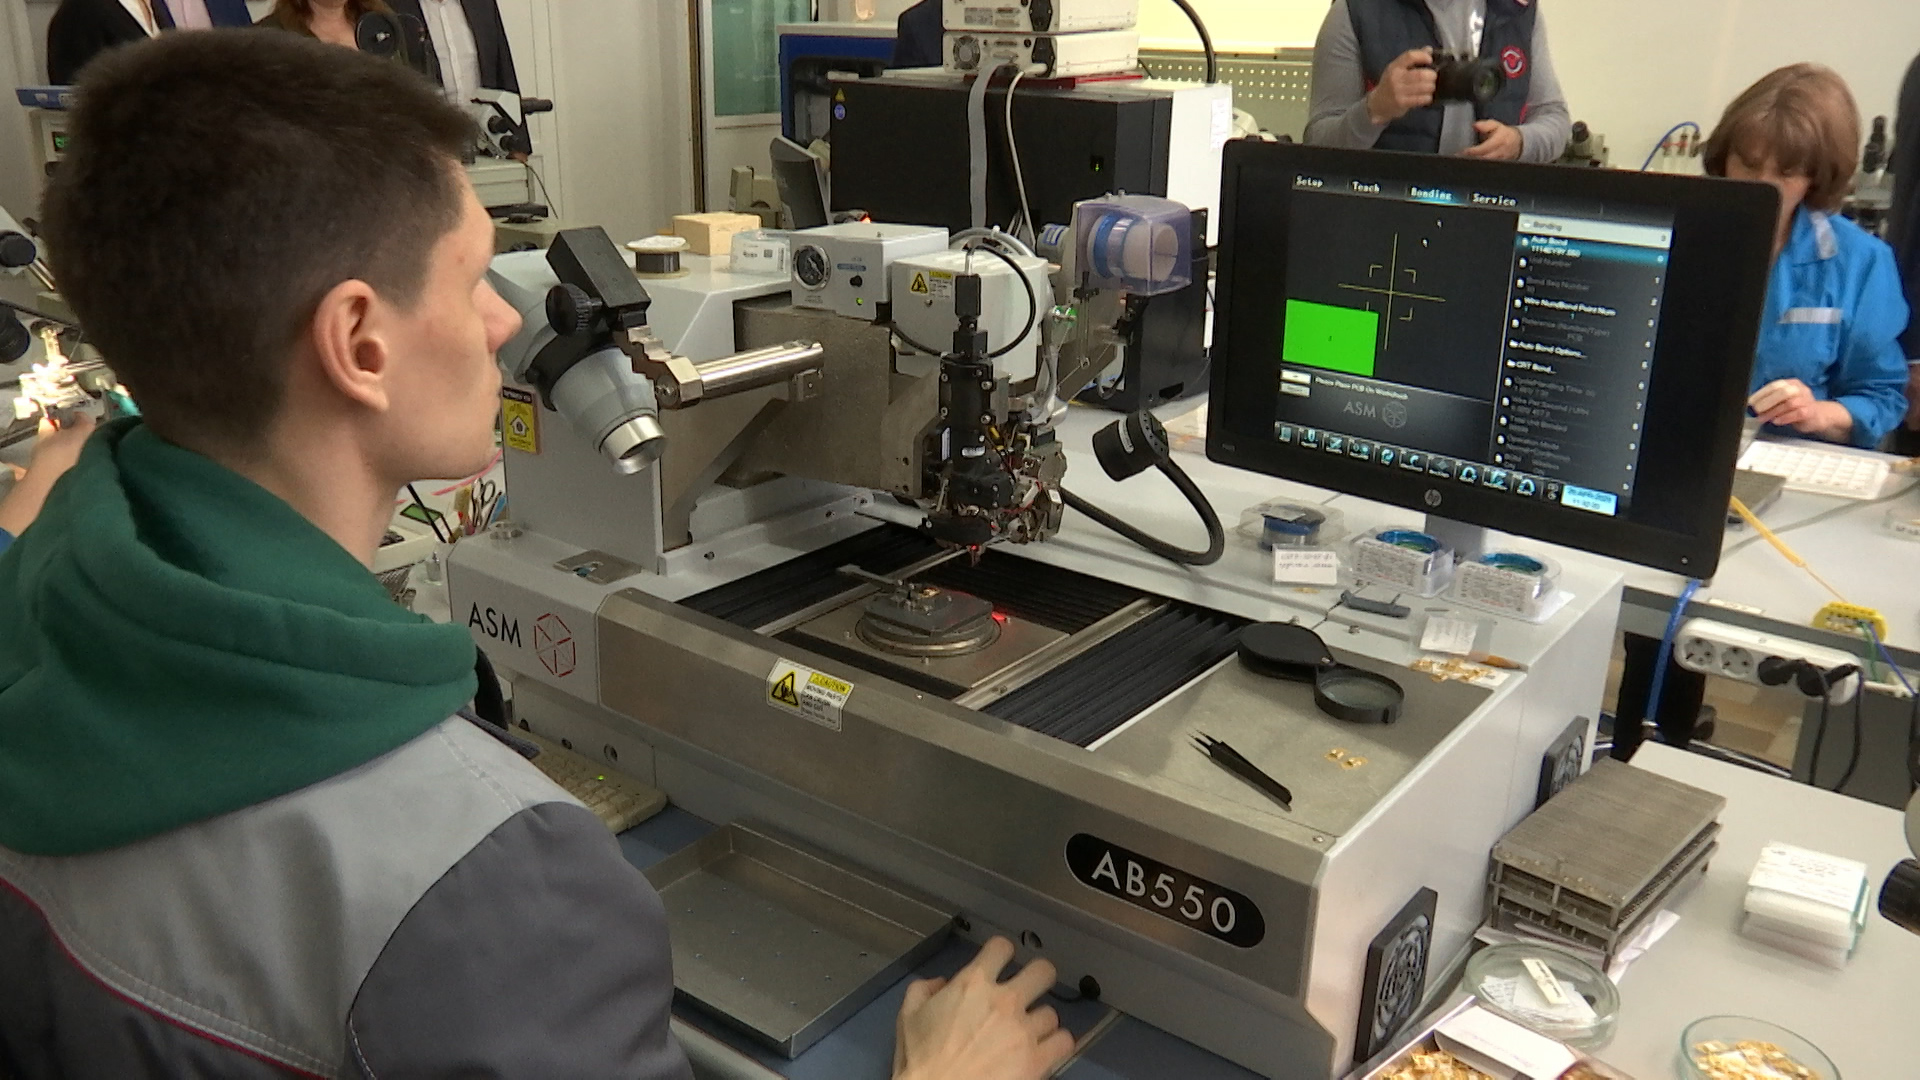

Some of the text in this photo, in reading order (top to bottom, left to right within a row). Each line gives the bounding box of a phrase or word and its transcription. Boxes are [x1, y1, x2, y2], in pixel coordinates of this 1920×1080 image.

[1295, 175, 1323, 189] Setup
[1352, 180, 1380, 194] Teach
[1410, 186, 1452, 202] Bonding
[1472, 192, 1517, 207] Service
[1343, 401, 1377, 418] ASM
[1424, 488, 1442, 508] hp
[468, 601, 522, 648] ASM
[819, 675, 847, 692] CAUTION
[1091, 850, 1236, 933] AB550
